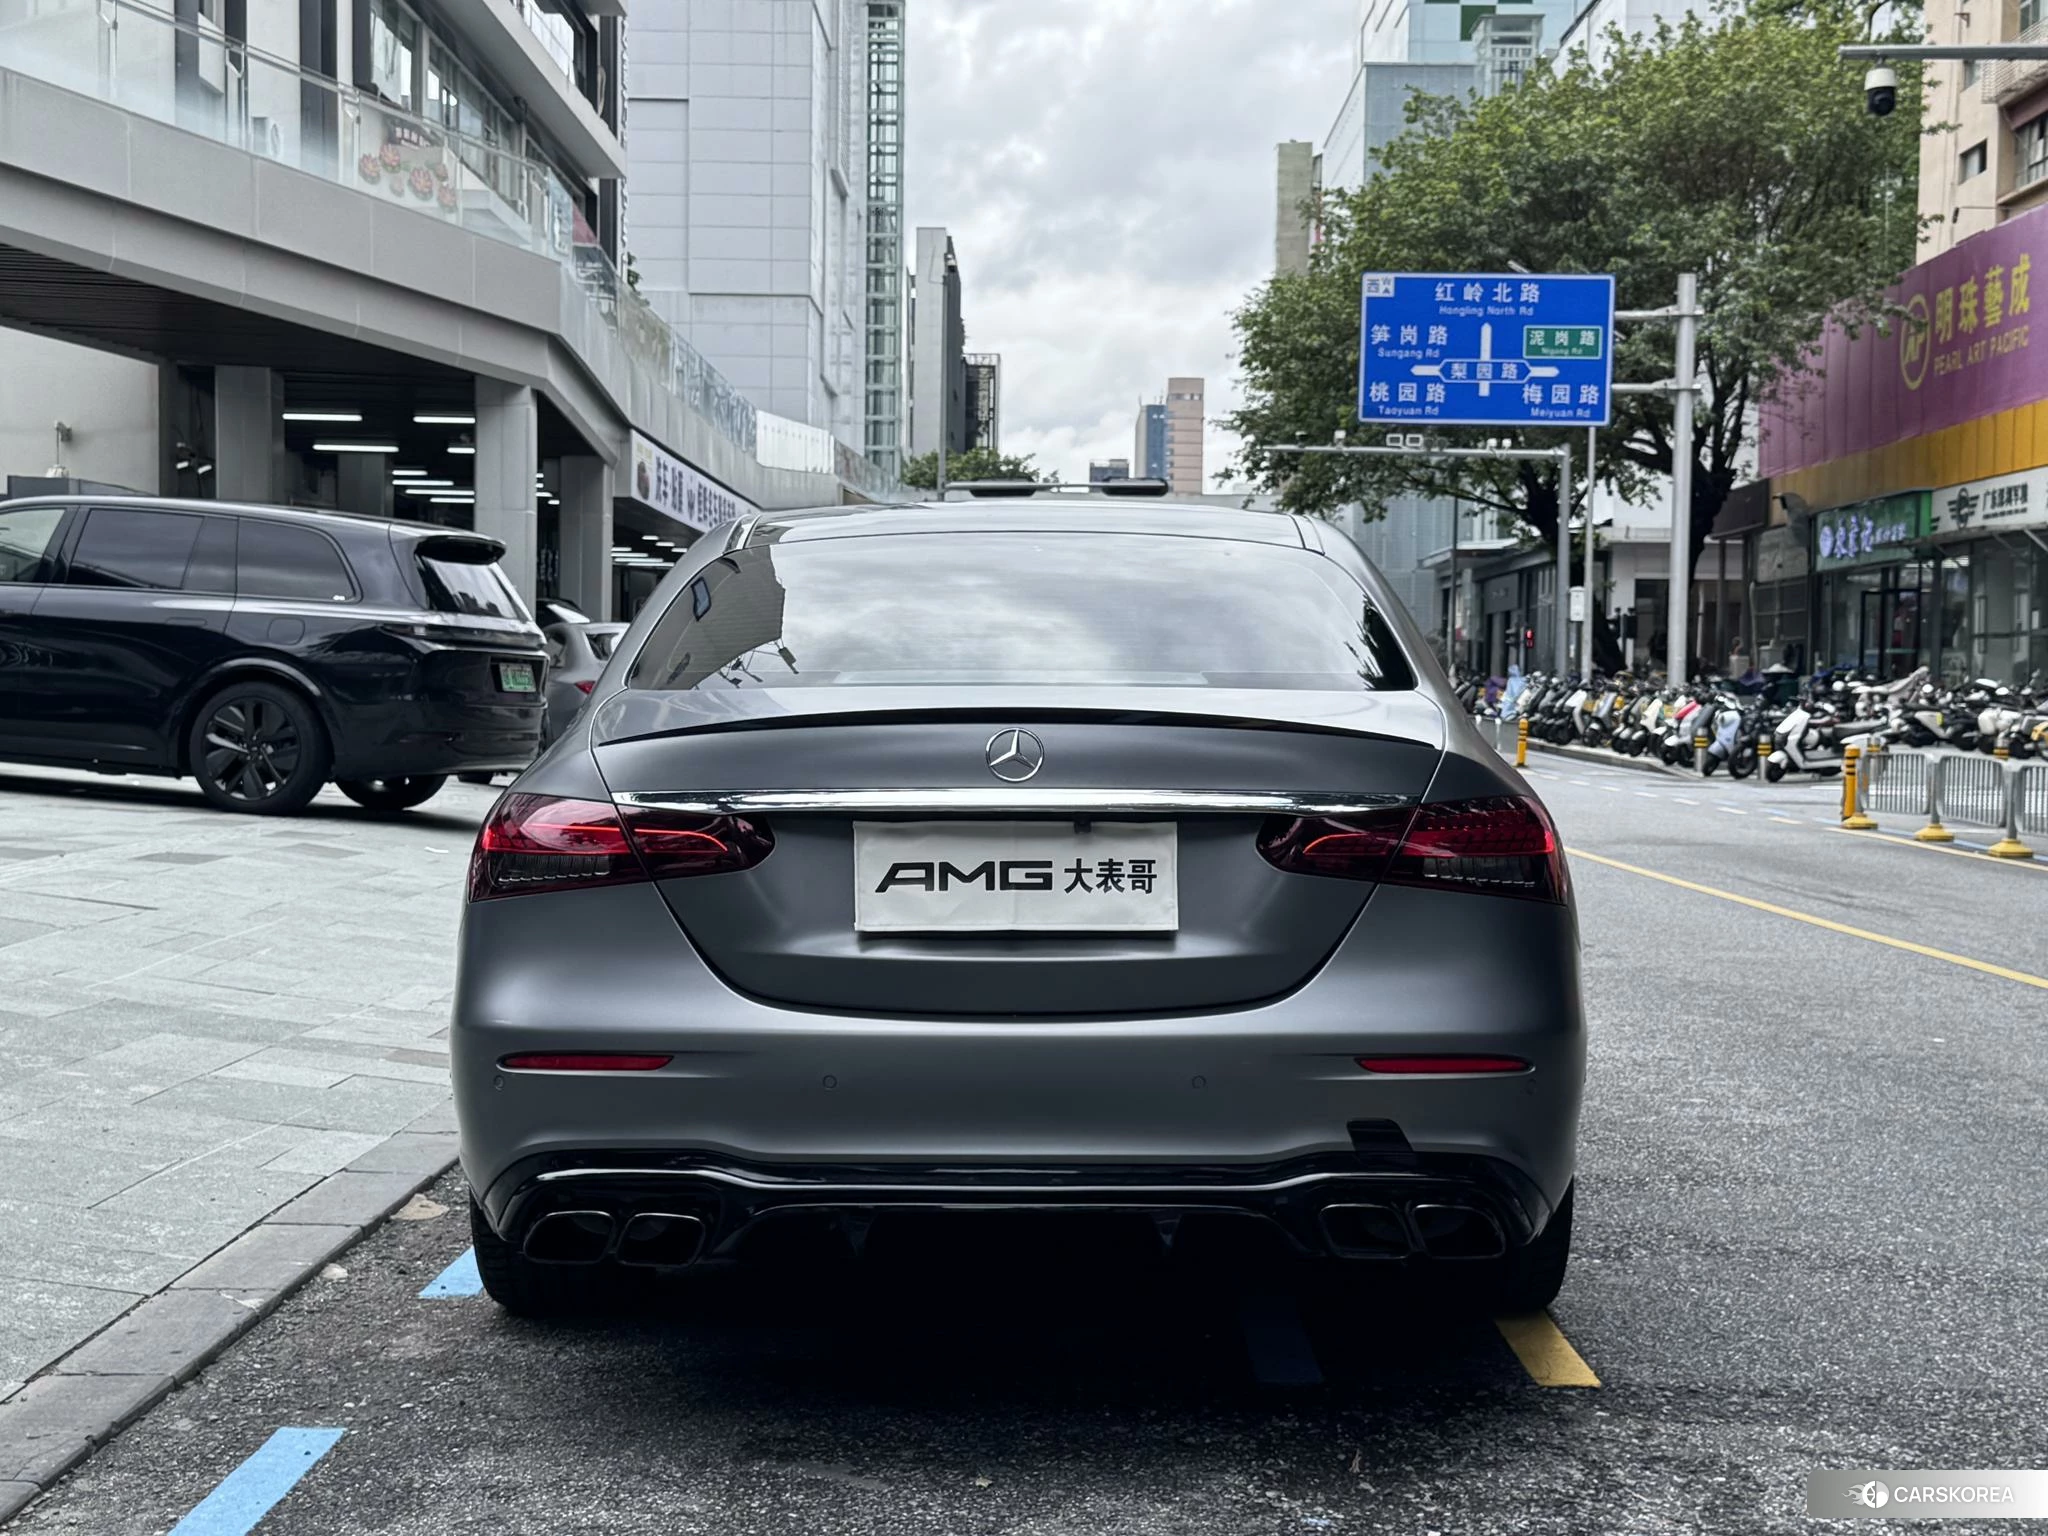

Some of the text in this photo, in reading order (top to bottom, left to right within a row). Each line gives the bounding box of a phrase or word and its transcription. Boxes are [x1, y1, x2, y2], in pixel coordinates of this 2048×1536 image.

[1367, 279, 1379, 293] 西
[1435, 282, 1540, 303] 红岭北路
[1439, 306, 1533, 317] Hongling North Rd
[1370, 324, 1448, 346] 笋岗路
[1529, 330, 1595, 346] 泥岗路
[1377, 347, 1440, 359] Sungang Rd
[1934, 325, 2030, 375] PEARL ART PACIFIC
[1450, 363, 1518, 379] 梨园路
[1369, 381, 1446, 403] 桃园路
[1522, 383, 1600, 405] 梅园路
[1378, 405, 1440, 416] Taoyuan Rd
[1530, 407, 1591, 418] Meiyuan Rd
[874, 858, 1157, 895] AMG 大表哥
